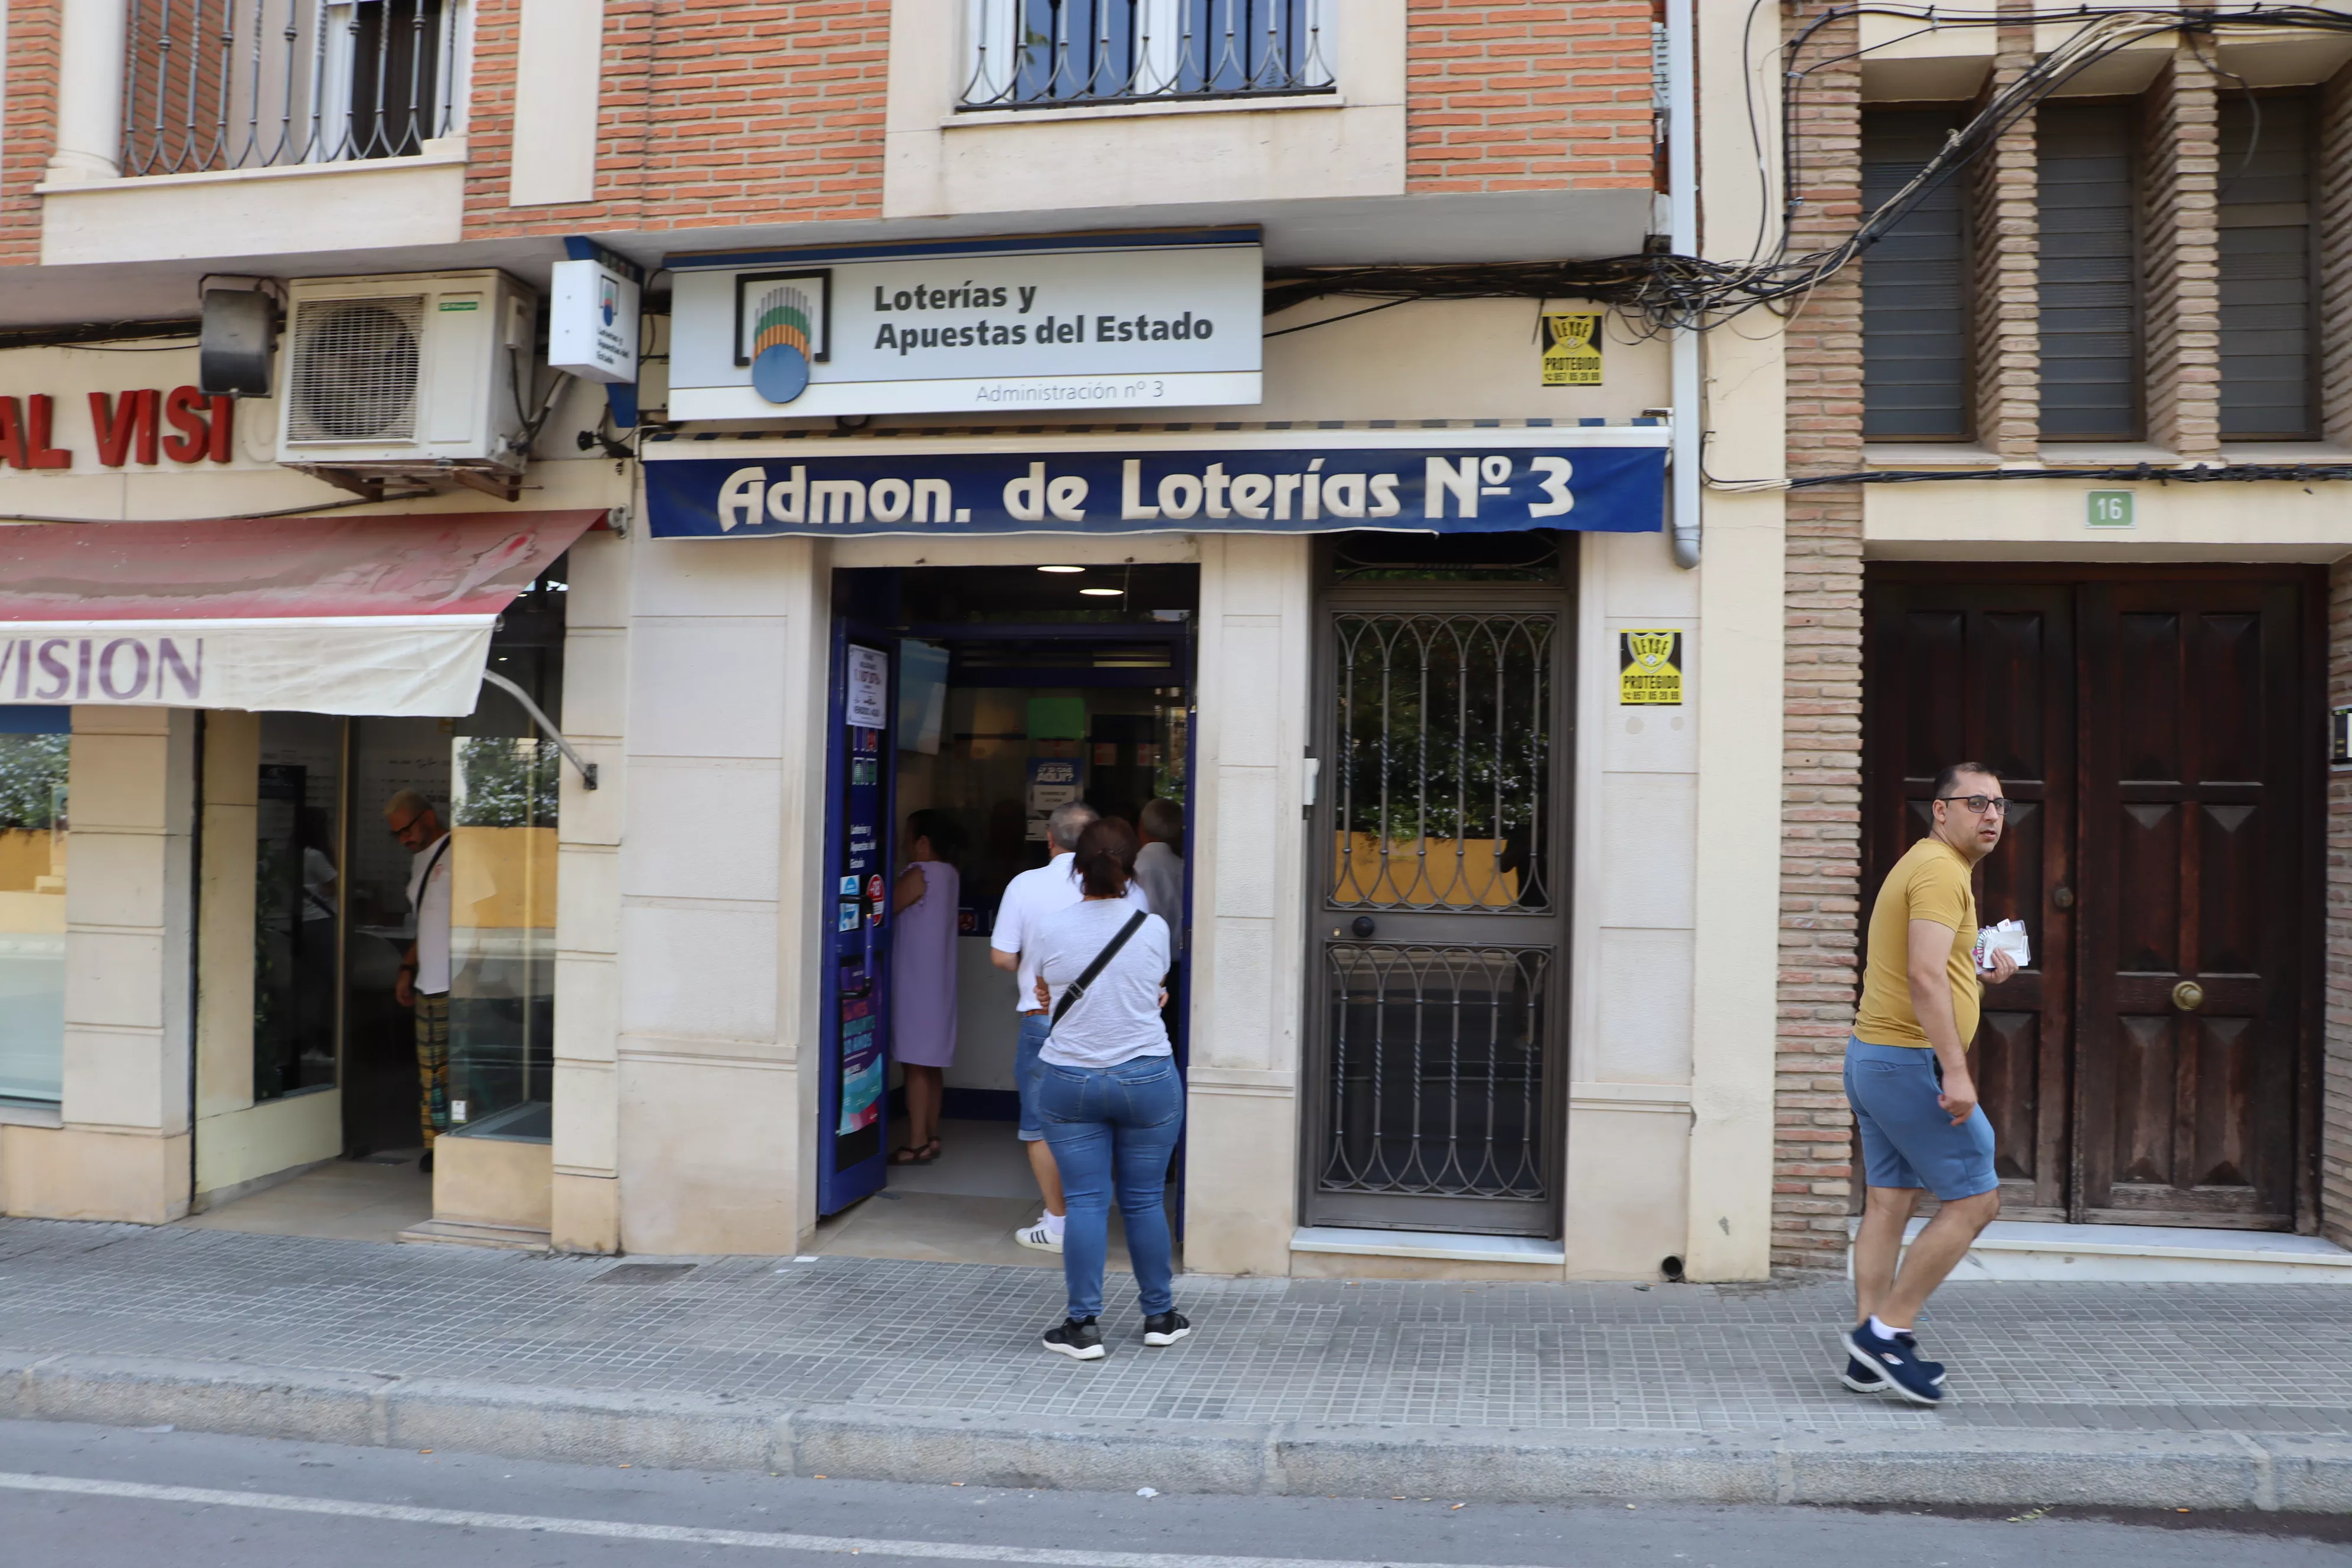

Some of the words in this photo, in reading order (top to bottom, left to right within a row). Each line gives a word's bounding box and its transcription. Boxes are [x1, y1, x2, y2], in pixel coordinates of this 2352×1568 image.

[875, 280, 1007, 312] Loterías
[1019, 285, 1037, 314] y
[875, 320, 1027, 356] Apuestas
[1035, 315, 1084, 344] del
[1096, 312, 1213, 342] Estado
[1554, 321, 1590, 338] LEYSE
[1545, 357, 1600, 371] PROTEGIDO
[975, 382, 1118, 403] Administración
[1152, 380, 1165, 397] 3
[717, 465, 972, 533] Admon.
[1003, 461, 1089, 522] de
[1122, 458, 1402, 520] Loterías
[1528, 456, 1575, 518] 3
[2096, 498, 2123, 520] 16
[1632, 638, 1670, 655] LEYSE
[1623, 675, 1680, 689] PROTEGIDO
